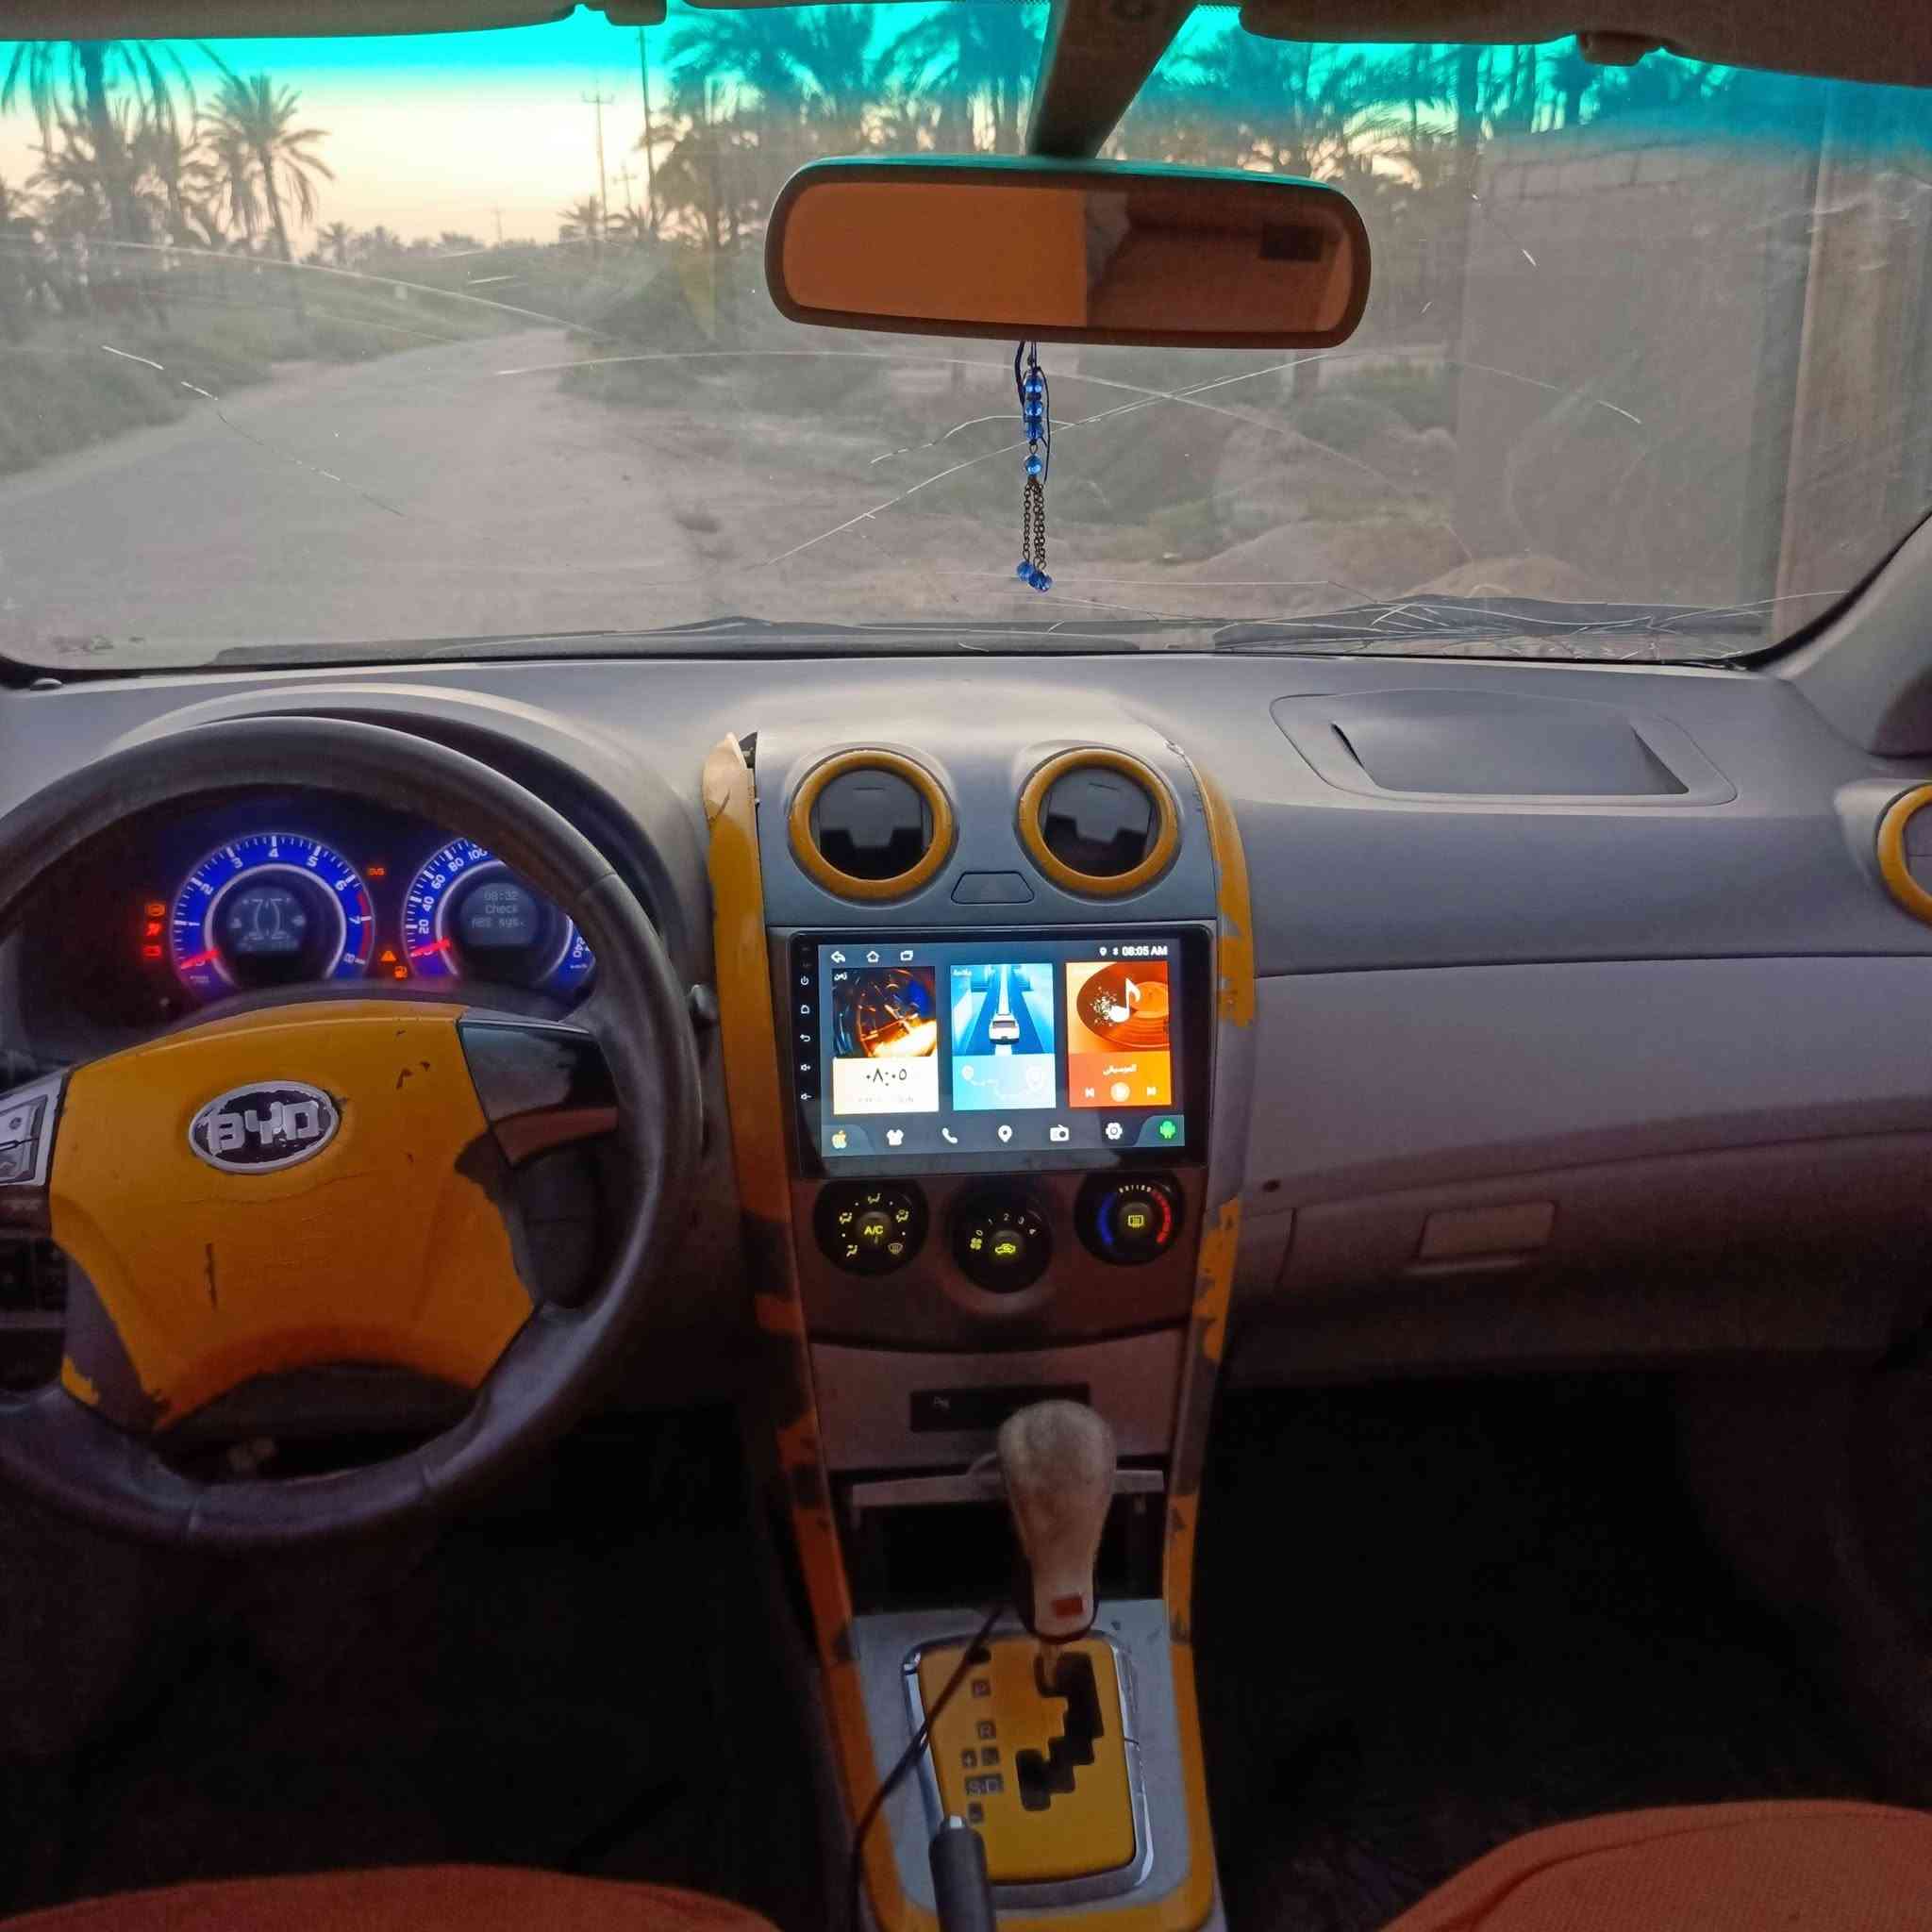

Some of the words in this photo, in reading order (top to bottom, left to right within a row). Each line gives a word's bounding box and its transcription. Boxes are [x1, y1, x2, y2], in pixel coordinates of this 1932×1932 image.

[269, 849, 278, 859] 4
[233, 858, 243, 869] 3
[307, 855, 319, 868] 5
[447, 857, 465, 873] 80
[335, 880, 348, 891] 6
[430, 874, 447, 890] 60
[200, 881, 214, 895] 2
[422, 895, 435, 912] 40
[485, 904, 518, 914] Check
[348, 915, 360, 925] 7
[418, 919, 430, 936] 20
[1151, 945, 1168, 956] AM
[343, 953, 356, 964] 8
[207, 1099, 320, 1156] BYD
[1003, 1212, 1011, 1222] 2
[863, 1224, 885, 1236] A/C
